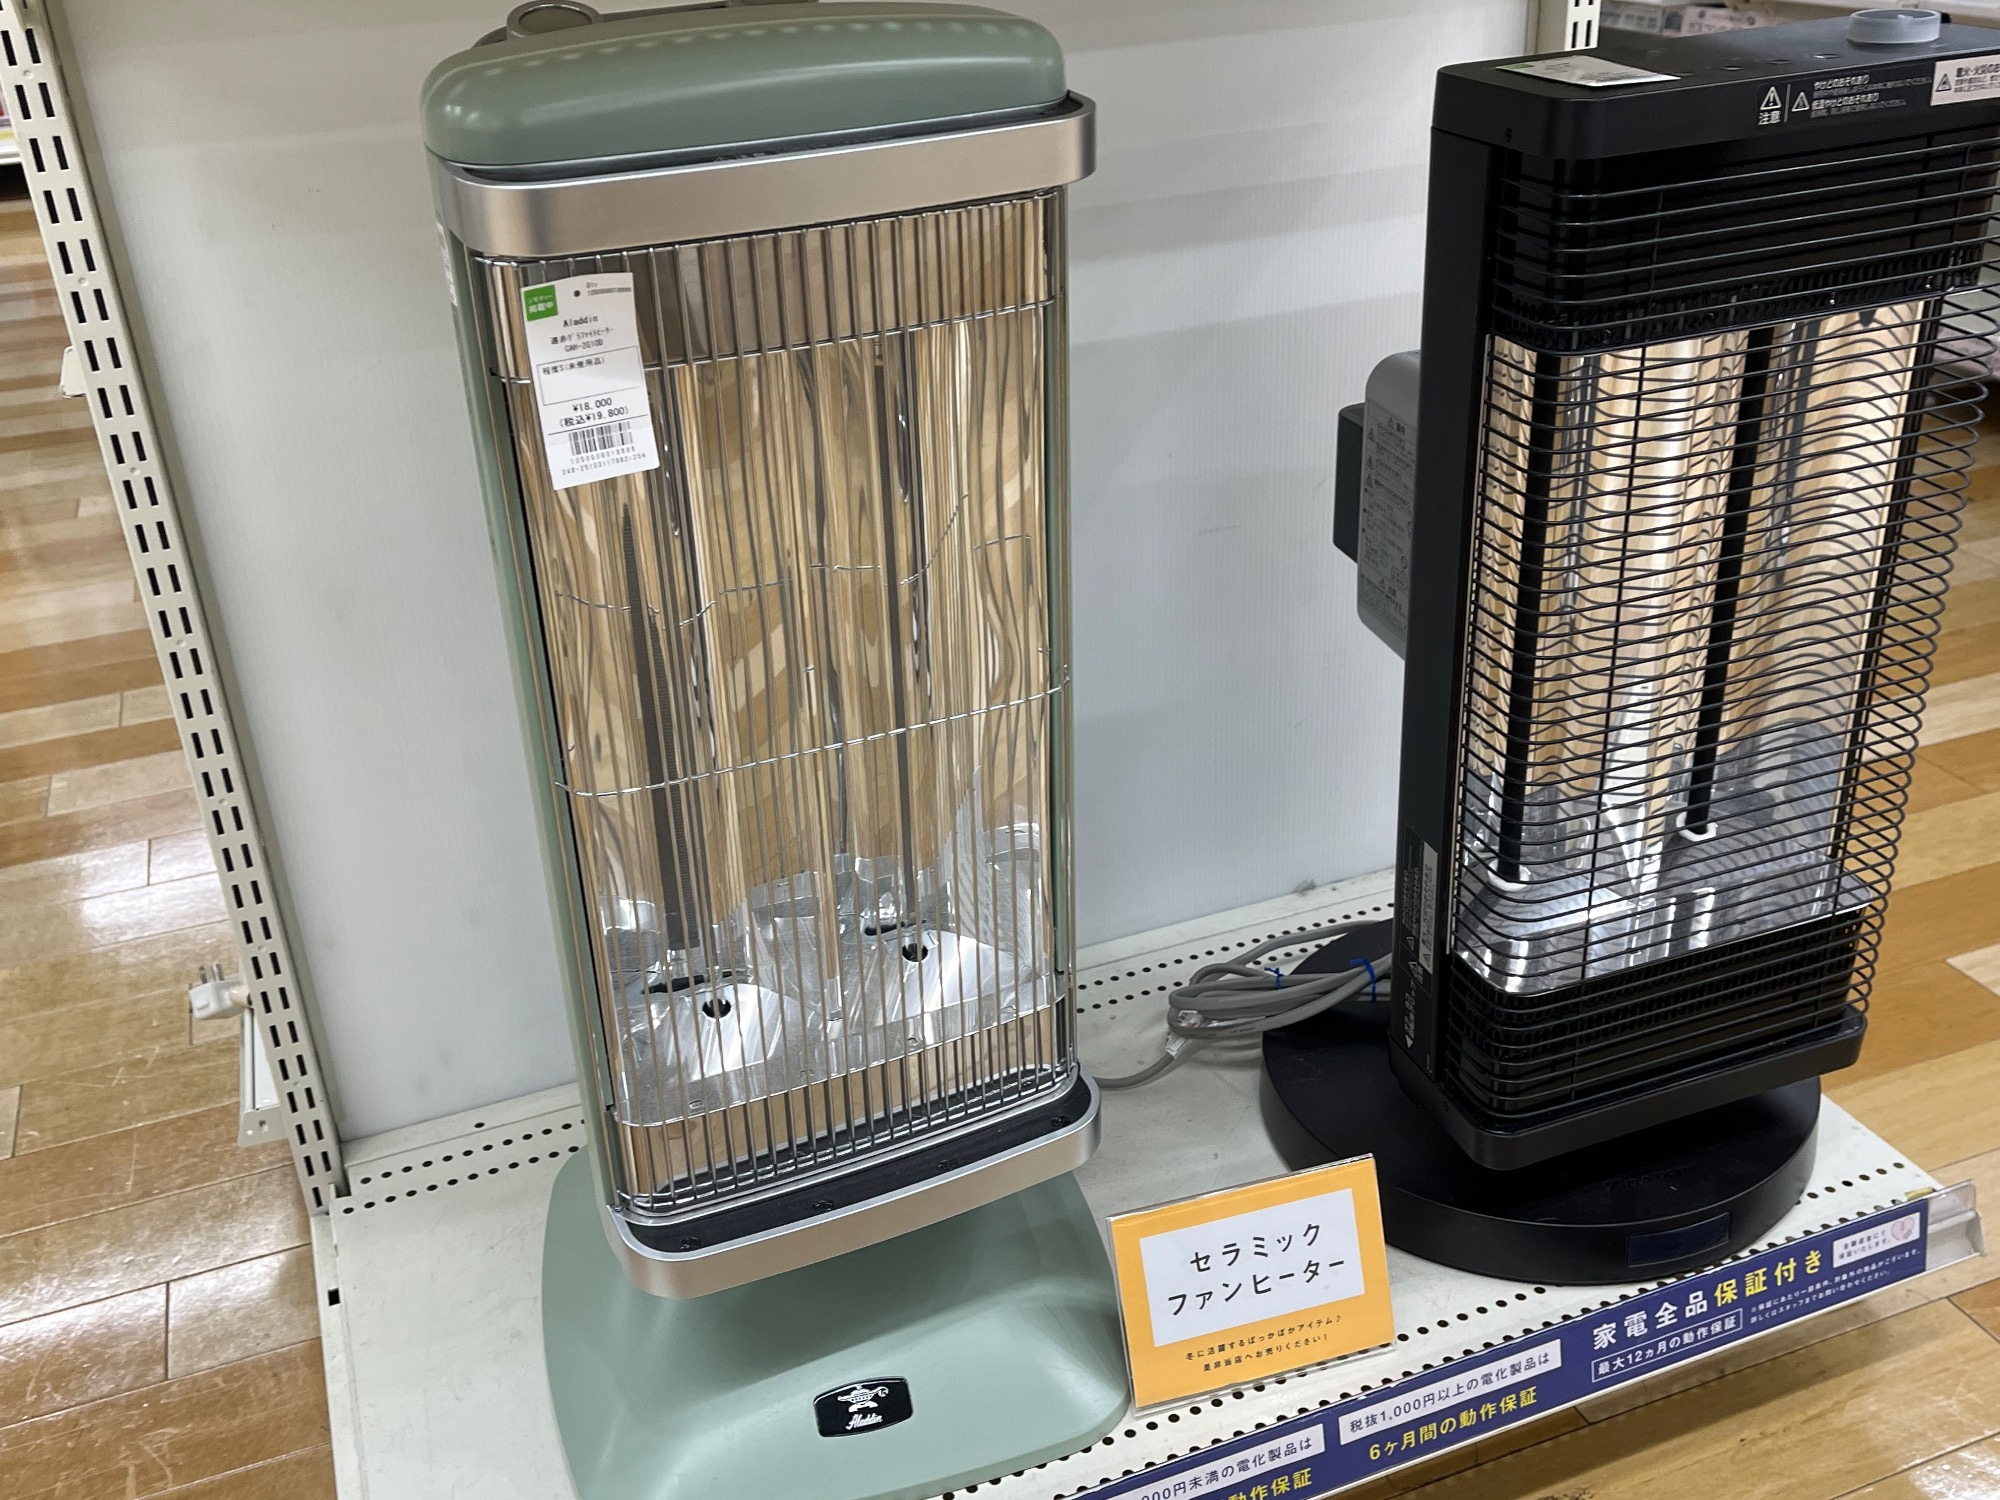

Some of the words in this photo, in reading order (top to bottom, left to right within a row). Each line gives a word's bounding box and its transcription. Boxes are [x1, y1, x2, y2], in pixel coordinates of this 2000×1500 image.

[1758, 111, 1781, 125] 注意
[563, 316, 598, 327] Aladdin
[1190, 1222, 1321, 1273] セラミック
[1168, 1259, 1345, 1316] ファンヒーター
[1593, 1250, 1822, 1350] 家電全品保証付き
[1349, 1352, 1550, 1433] 税抜1,000円以上の電化製品は
[846, 1412, 883, 1430] Aladdin
